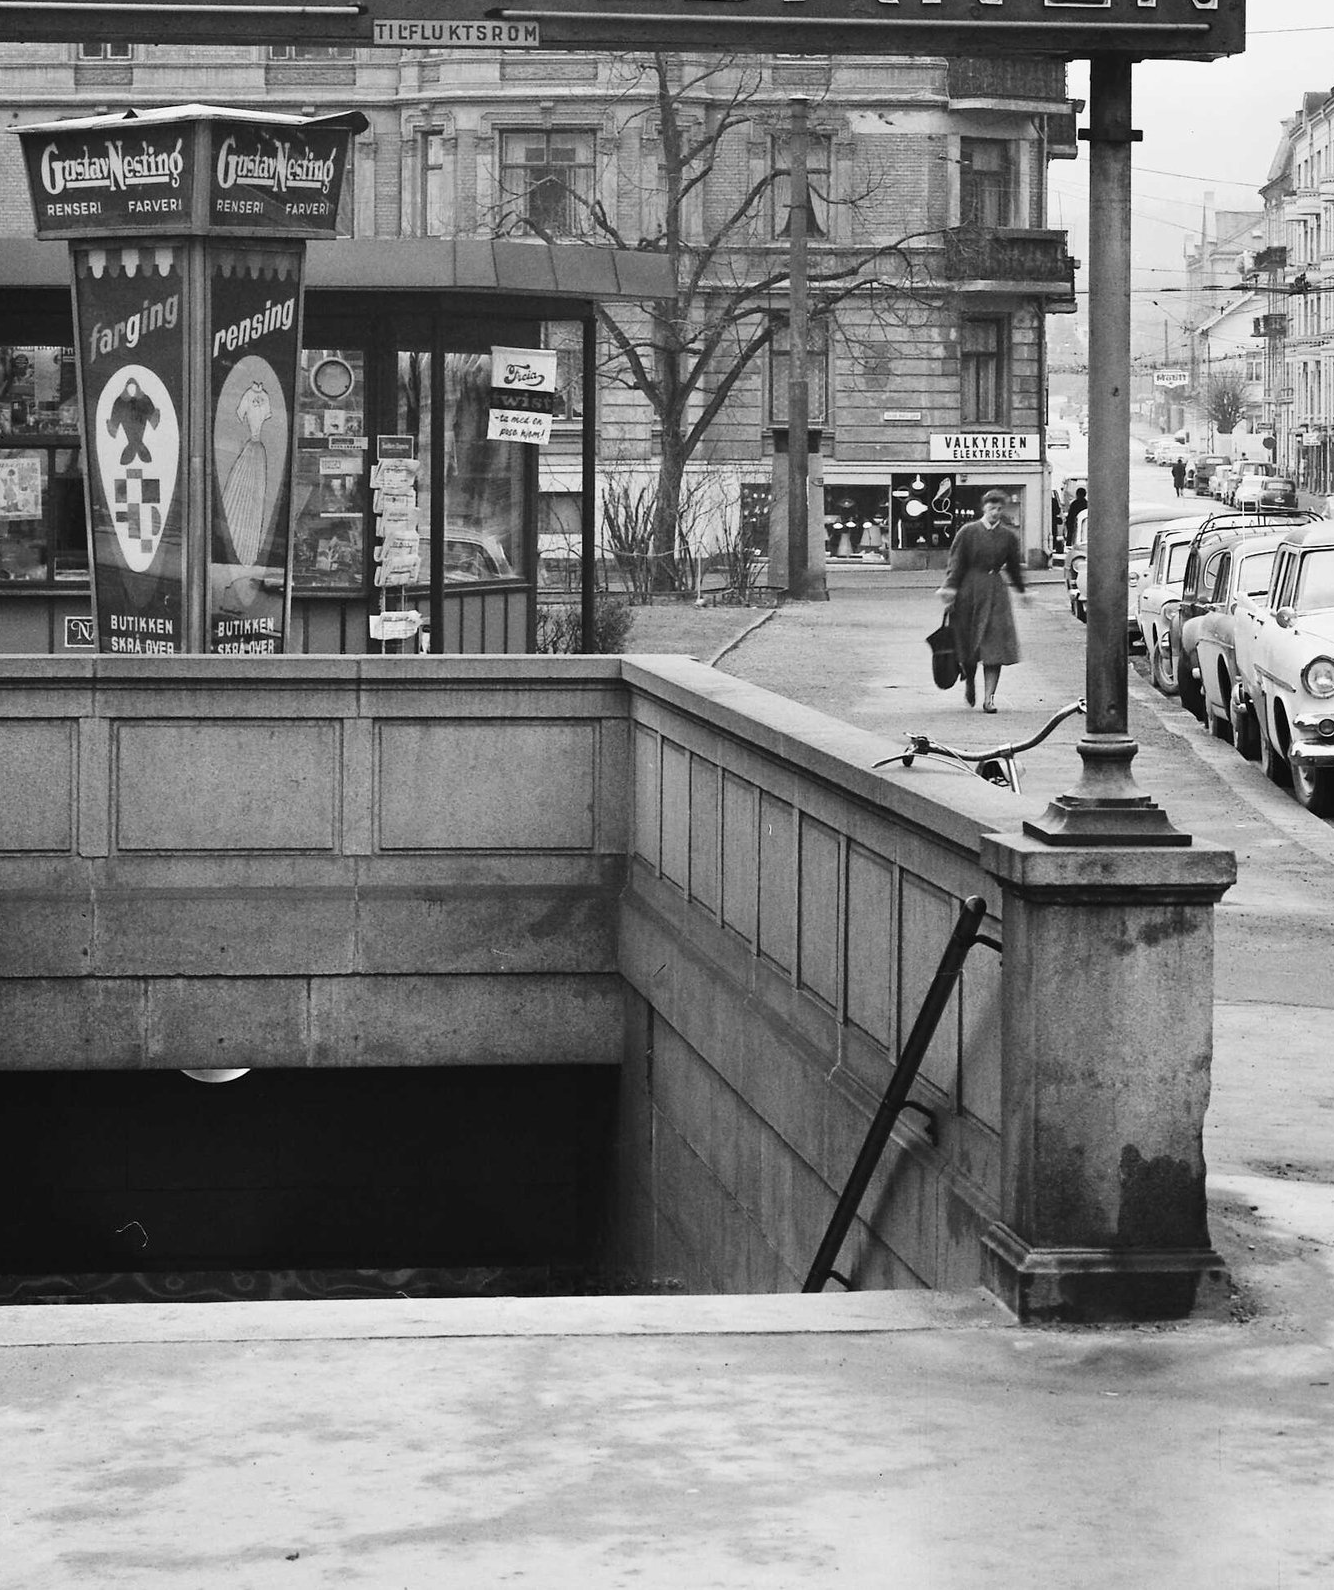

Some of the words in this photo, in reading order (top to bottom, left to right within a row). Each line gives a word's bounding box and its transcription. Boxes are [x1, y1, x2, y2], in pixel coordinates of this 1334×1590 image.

[375, 24, 537, 42] TILFLUKTSROM
[48, 202, 101, 216] RENSERI
[128, 198, 182, 213] FARVERI
[217, 200, 264, 213] RENSERI
[286, 203, 329, 215] FARVERI
[89, 294, 179, 363] farging
[213, 298, 295, 358] rensing
[504, 364, 545, 386] Freia
[945, 437, 1027, 448] VALKYRIEN
[953, 450, 1013, 458] ELEKTRISKE
[110, 615, 173, 634] BUTIKKEN
[218, 617, 275, 637] BUTIKKEN
[111, 634, 142, 654] SKRÅ
[146, 640, 174, 654] OVER
[248, 640, 274, 654] OVER
